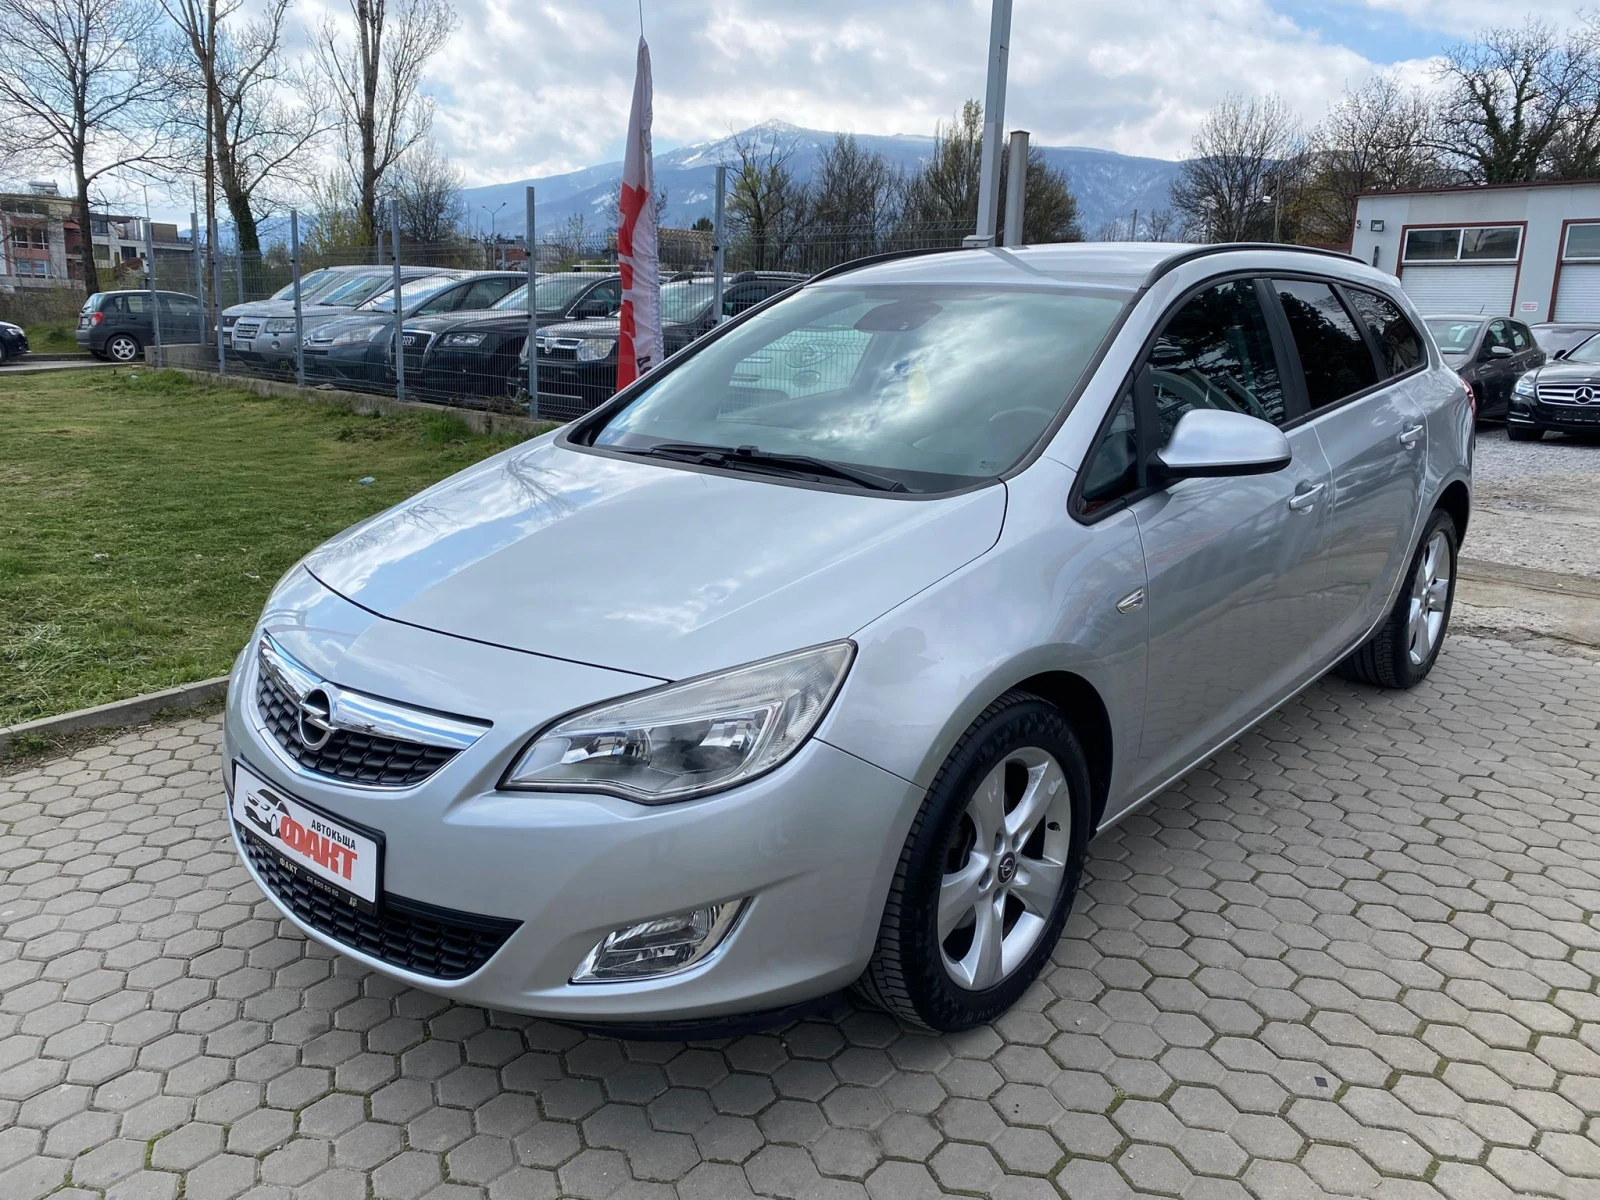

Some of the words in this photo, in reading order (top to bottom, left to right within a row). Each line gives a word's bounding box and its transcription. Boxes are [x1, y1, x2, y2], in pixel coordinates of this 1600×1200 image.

[280, 815, 358, 881] ФАКТ
[311, 819, 356, 850] АВТОКЪЩА
[279, 857, 298, 875] ФАКТ
